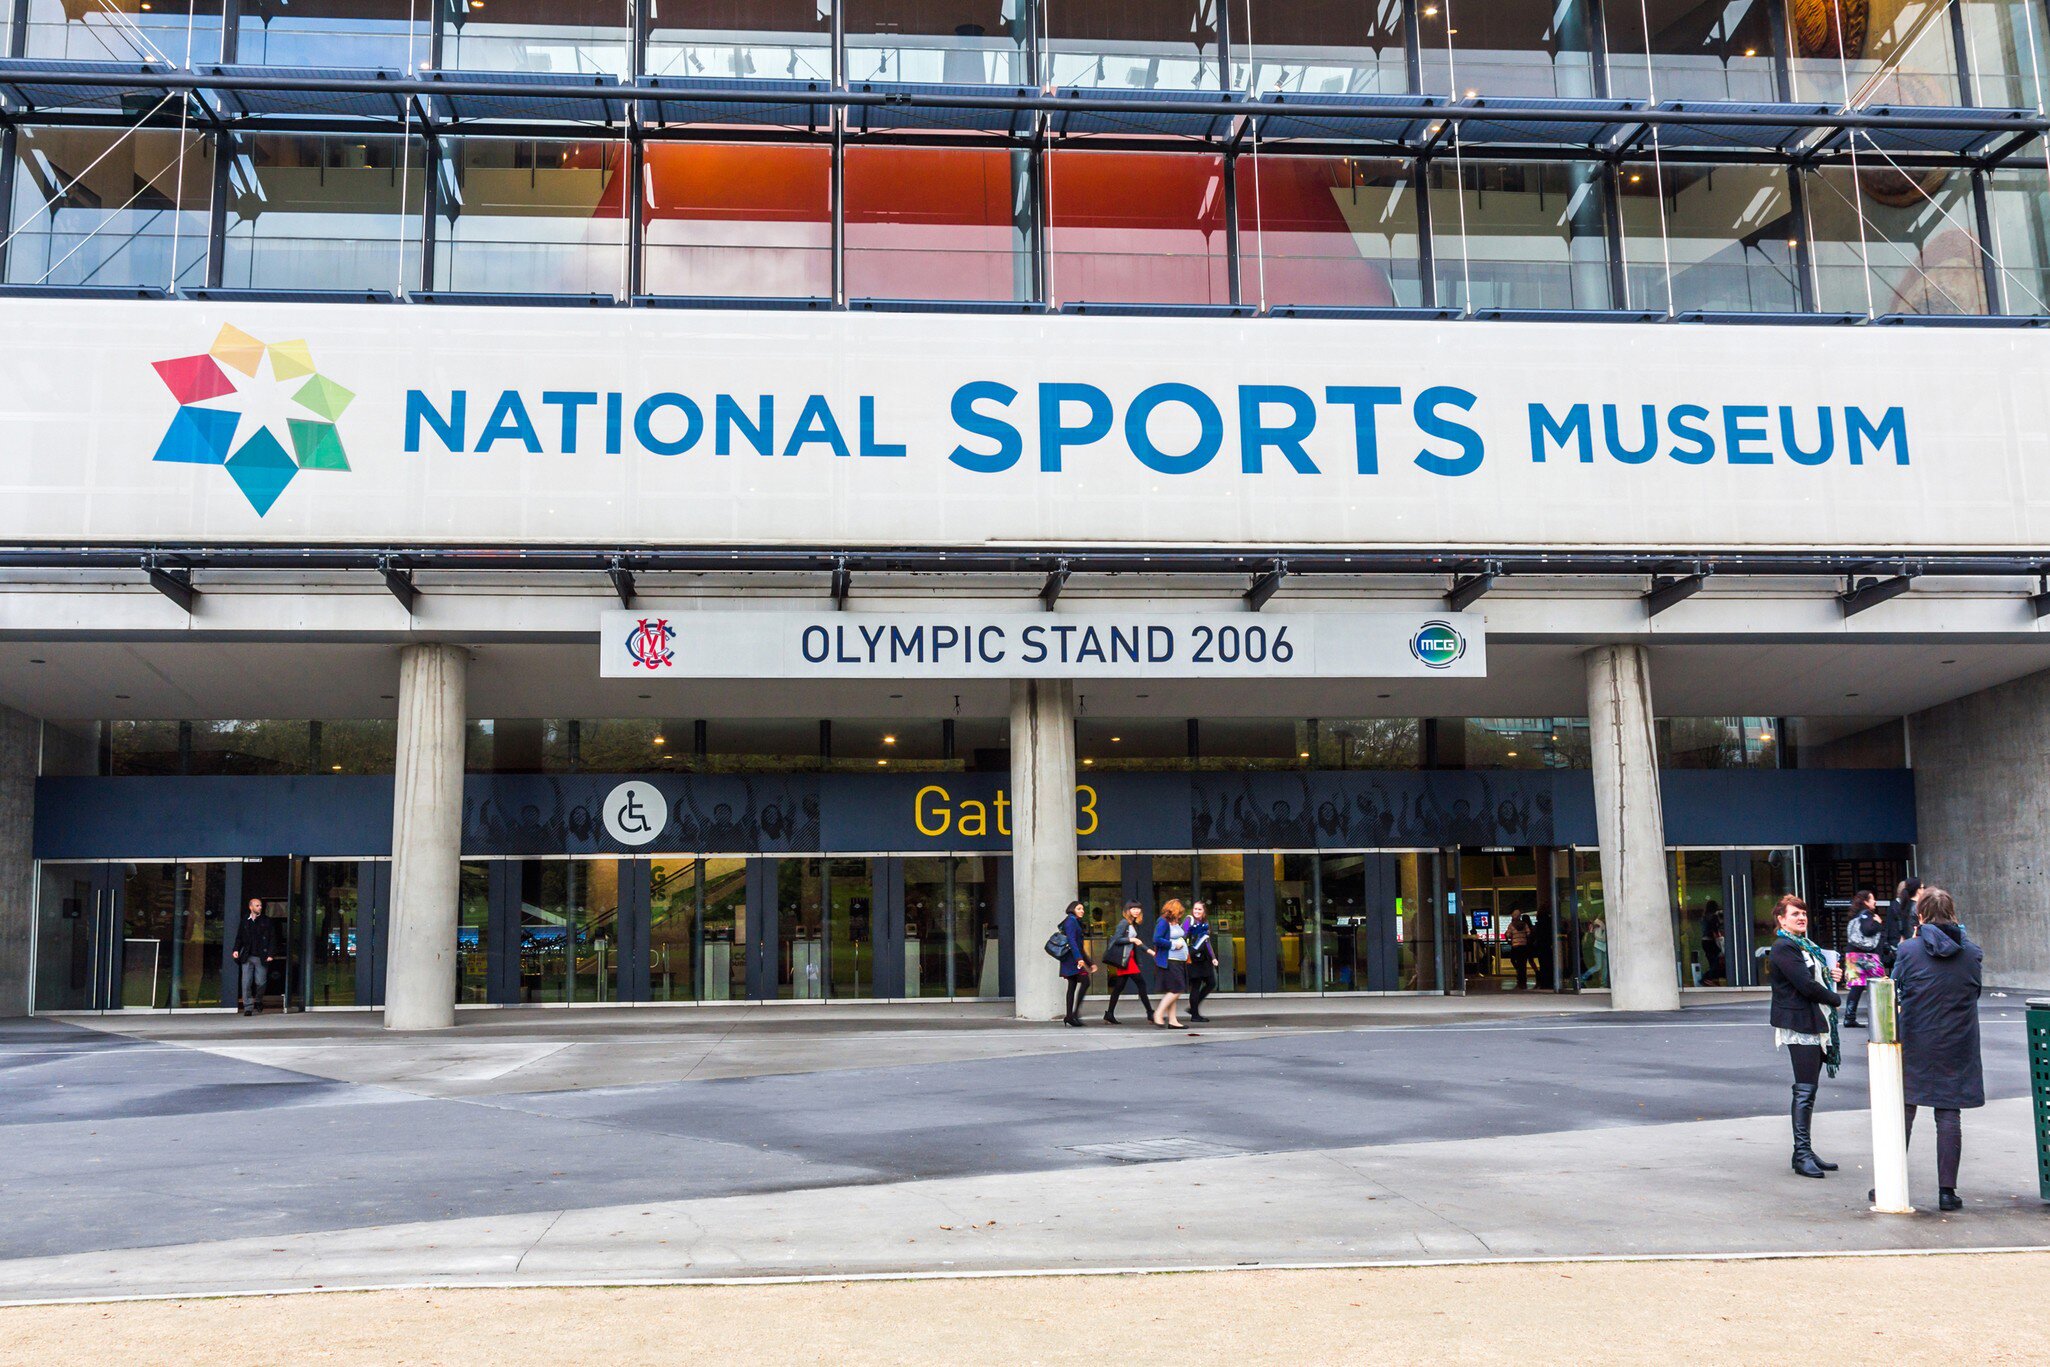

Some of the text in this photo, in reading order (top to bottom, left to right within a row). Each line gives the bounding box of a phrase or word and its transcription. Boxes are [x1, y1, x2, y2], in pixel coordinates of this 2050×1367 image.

[403, 380, 1911, 478] NATIONAL SPORTS MUSEUM
[802, 625, 1294, 664] OLYMPIC STAND 2006
[1421, 639, 1455, 651] MCG
[914, 784, 1100, 837] Gat 3
